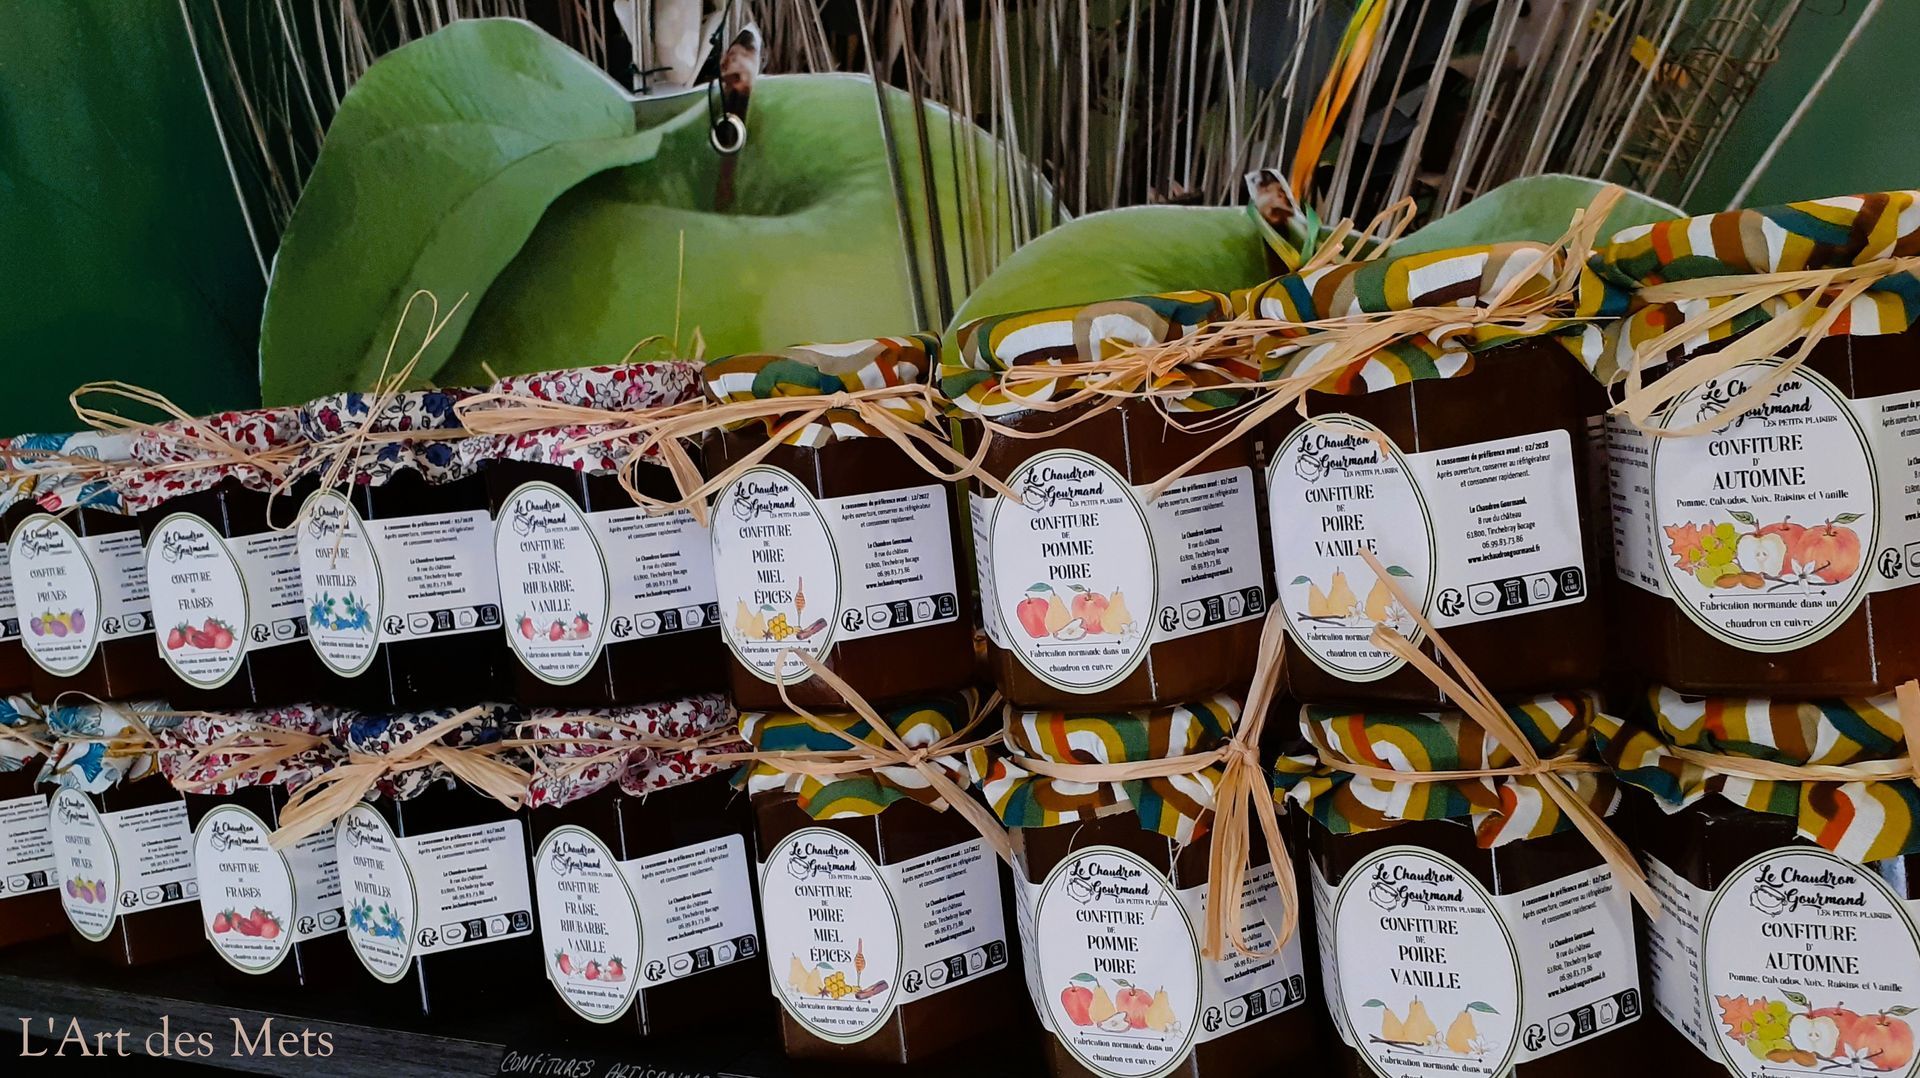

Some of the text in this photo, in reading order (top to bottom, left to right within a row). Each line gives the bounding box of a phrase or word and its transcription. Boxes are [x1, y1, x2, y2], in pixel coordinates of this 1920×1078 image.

[1297, 434, 1318, 455] Le
[1708, 434, 1802, 456] CONFITURE
[1320, 452, 1379, 477] Gourmand
[1024, 468, 1096, 486] Le Chaudron
[1712, 466, 1806, 490] AUTOMNE
[734, 482, 789, 499] Le Chaudron
[1045, 483, 1104, 507] Gourmand
[1305, 485, 1374, 503] CONFITURE
[1676, 489, 1849, 508] Pomme, Calvados, Noix, Raisins et Vanille
[514, 499, 560, 515] Le Chaudron
[751, 499, 796, 518] Gourmand
[1336, 504, 1345, 512] DE
[1476, 503, 1499, 512] Chaudron
[529, 515, 566, 533] Gourmand
[1031, 513, 1099, 531] CONFITURE
[1321, 514, 1364, 532] POIRE
[1501, 512, 1522, 521] château
[739, 524, 792, 539] CONFITURE
[520, 538, 565, 552] CONFITURE
[1042, 540, 1094, 558] POMME
[752, 549, 784, 564] POIRE
[171, 571, 211, 585] CONFITURE
[316, 574, 357, 587] MYRTILLES
[757, 570, 785, 583] MIEL
[1049, 564, 1091, 581] POIRE
[178, 597, 214, 610] FRAISES
[531, 599, 572, 613] VANILLE
[754, 590, 792, 605] ÉPICES
[1700, 598, 1838, 610] Fabrication normande dans un
[1726, 618, 1813, 628] chaudron en cuivre
[789, 841, 849, 859] Le Chaudron
[219, 863, 260, 873] CONFITURE
[566, 856, 600, 873] Gourmand
[808, 861, 857, 879] Gourmand
[1069, 860, 1142, 881] Le Chaudron
[1371, 863, 1455, 885] Le Chaudron
[1754, 864, 1857, 889] Le Chaudron
[226, 886, 261, 898] FRAISES
[558, 881, 600, 894] CONFITURE
[794, 885, 852, 898] CONFITURE
[1091, 880, 1149, 900] Gourmand
[1396, 888, 1464, 909] Gourmand
[1784, 889, 1866, 912] Gourmand
[808, 908, 844, 923] POIRE
[1076, 909, 1145, 925] CONFITURE
[1380, 917, 1458, 935] CONFITURE
[1761, 922, 1857, 942] CONFITURE
[814, 928, 843, 943] MIEL
[1086, 935, 1139, 951] POMME
[1415, 935, 1426, 944] DE
[568, 938, 606, 953] VANILLE
[1398, 944, 1447, 964] POIRE
[810, 946, 852, 963] ÉPICES
[1094, 958, 1136, 974] POIRE
[1765, 953, 1859, 975] AUTOMNE
[1390, 968, 1461, 989] VANILLE
[1728, 973, 1903, 993] Pomme, Calvados, Noix, Raisins et Vanille
